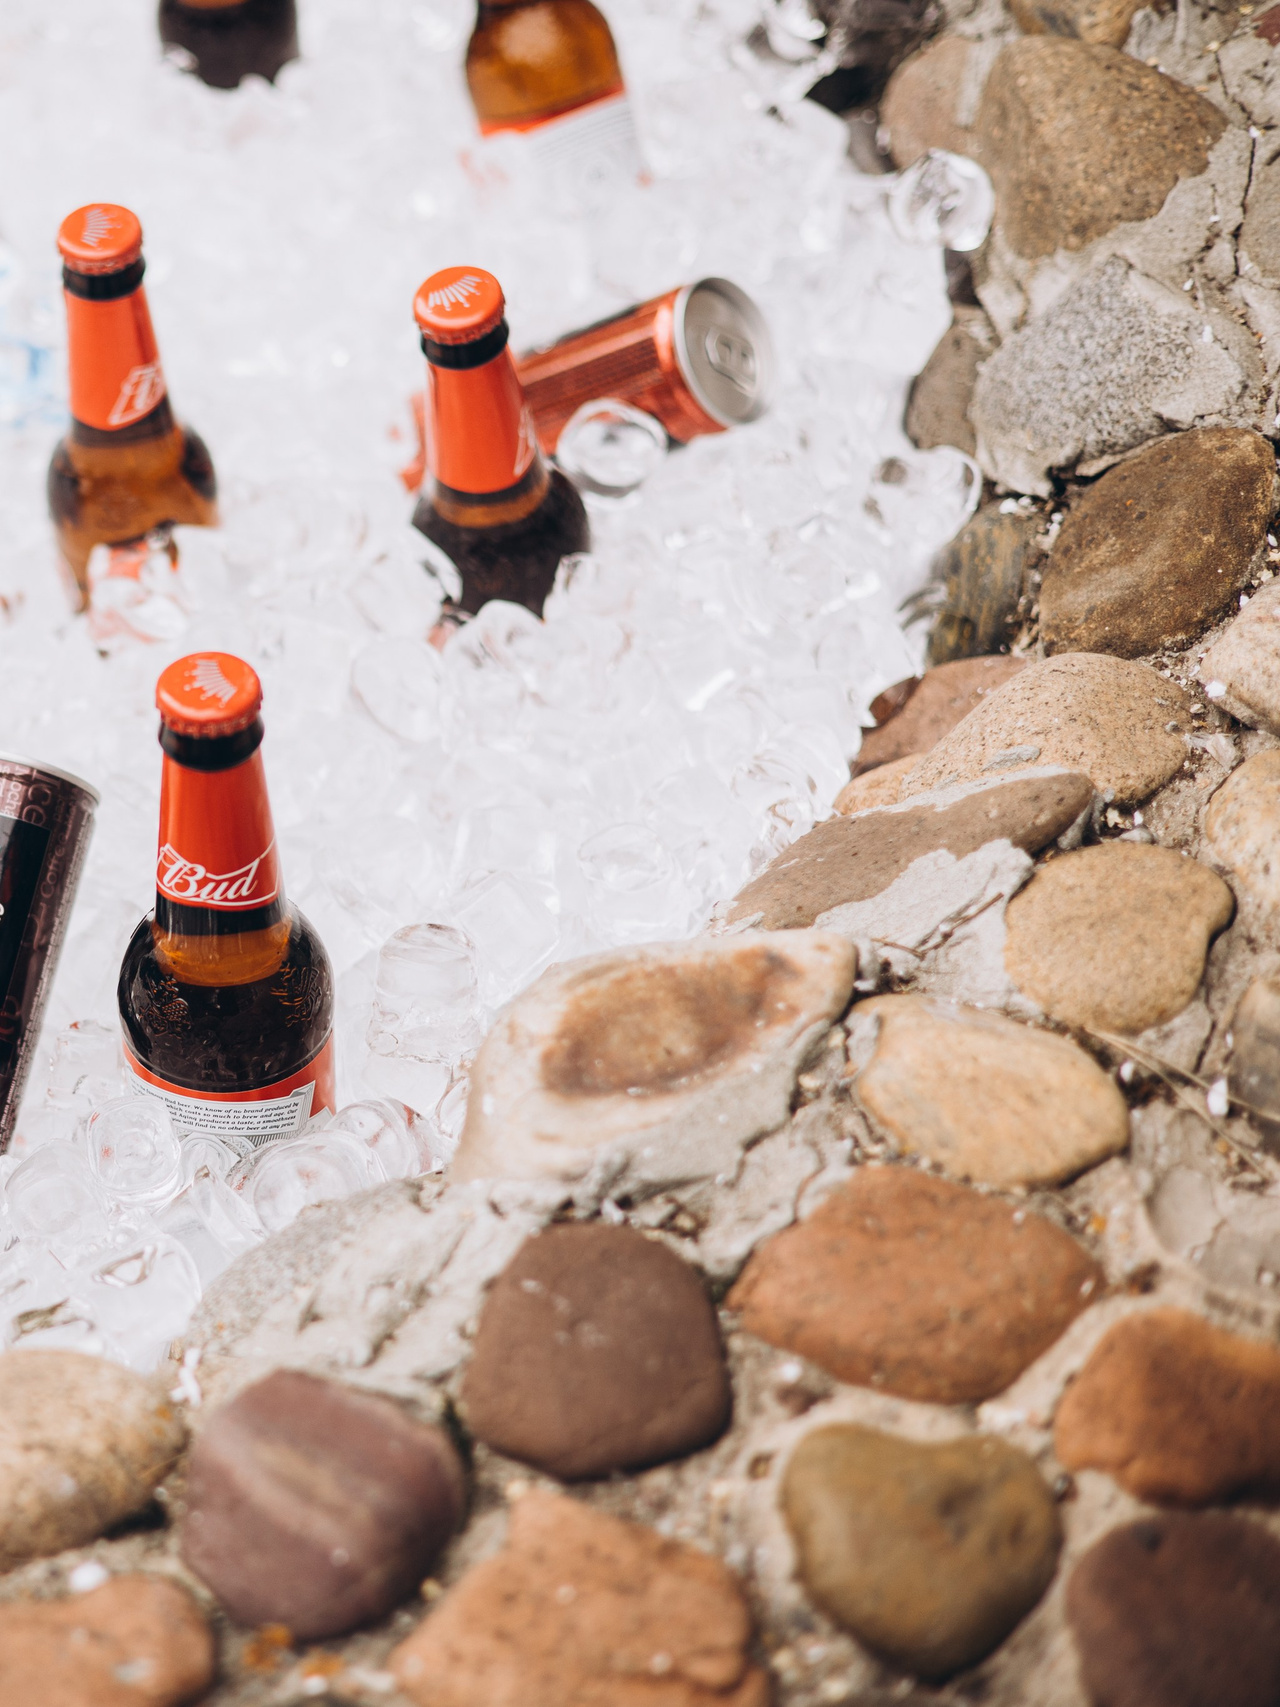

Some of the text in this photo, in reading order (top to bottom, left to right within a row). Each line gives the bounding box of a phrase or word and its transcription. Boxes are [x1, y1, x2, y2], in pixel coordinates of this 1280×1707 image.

[160, 848, 260, 901] Bud
[166, 1104, 183, 1112] which
[184, 1108, 201, 1116] costs
[178, 1101, 192, 1109] beer.
[264, 1102, 292, 1114] produced
[179, 1113, 198, 1122] Aging
[262, 1115, 296, 1124] smoothness
[280, 1121, 295, 1129] price.
